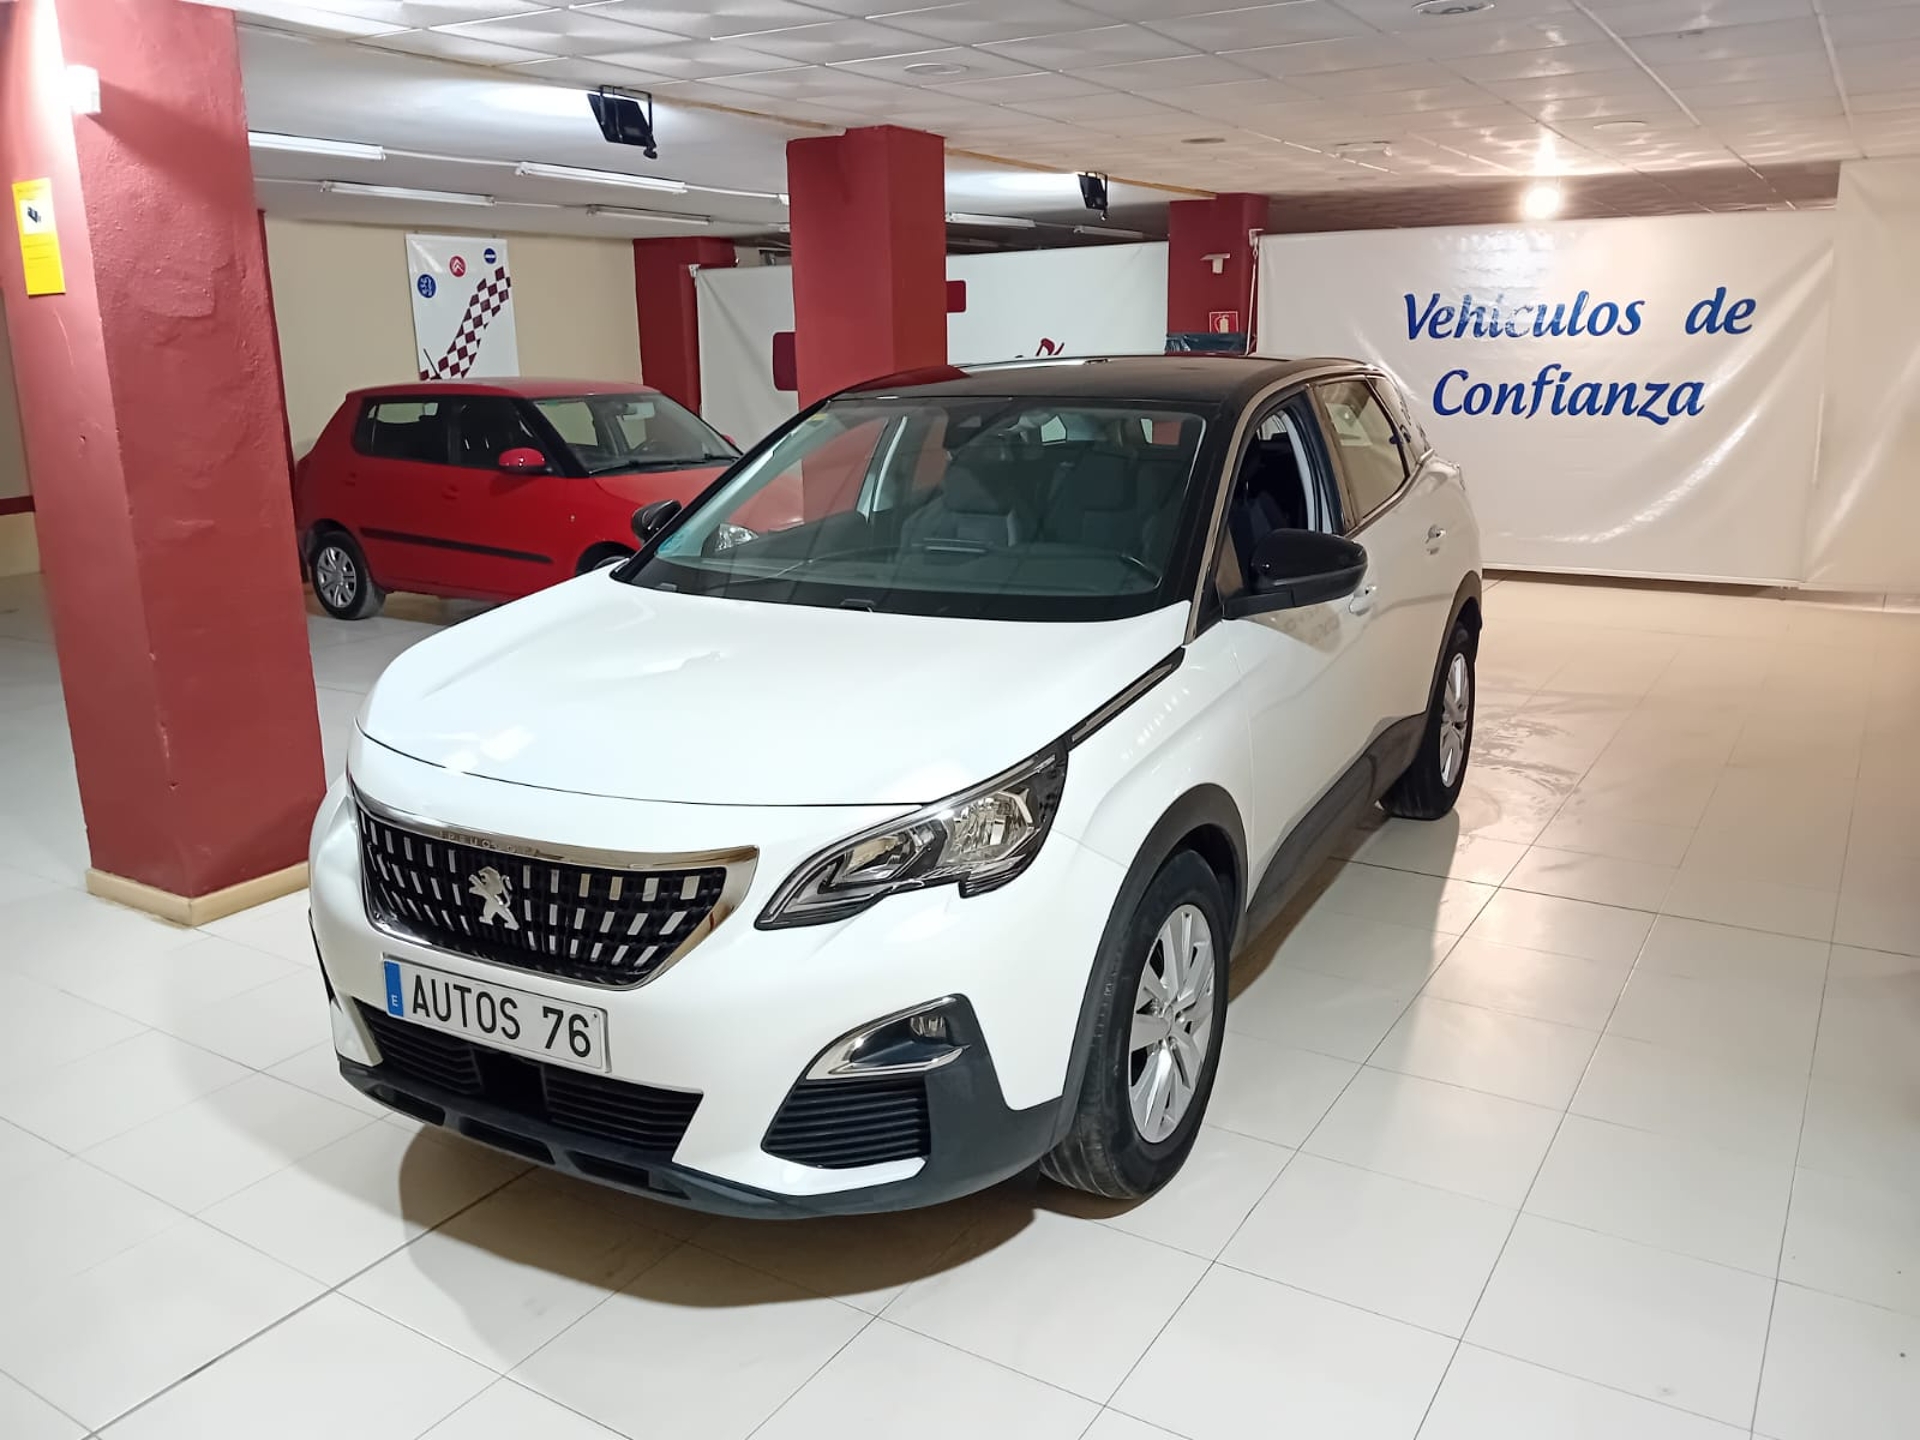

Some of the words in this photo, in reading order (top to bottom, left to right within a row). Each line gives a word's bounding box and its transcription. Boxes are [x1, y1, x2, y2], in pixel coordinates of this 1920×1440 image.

[1685, 287, 1757, 335] de
[1433, 363, 1706, 426] Confianza
[391, 994, 399, 1008] E
[412, 975, 521, 1040] AUTOS
[542, 1006, 591, 1058] 76
